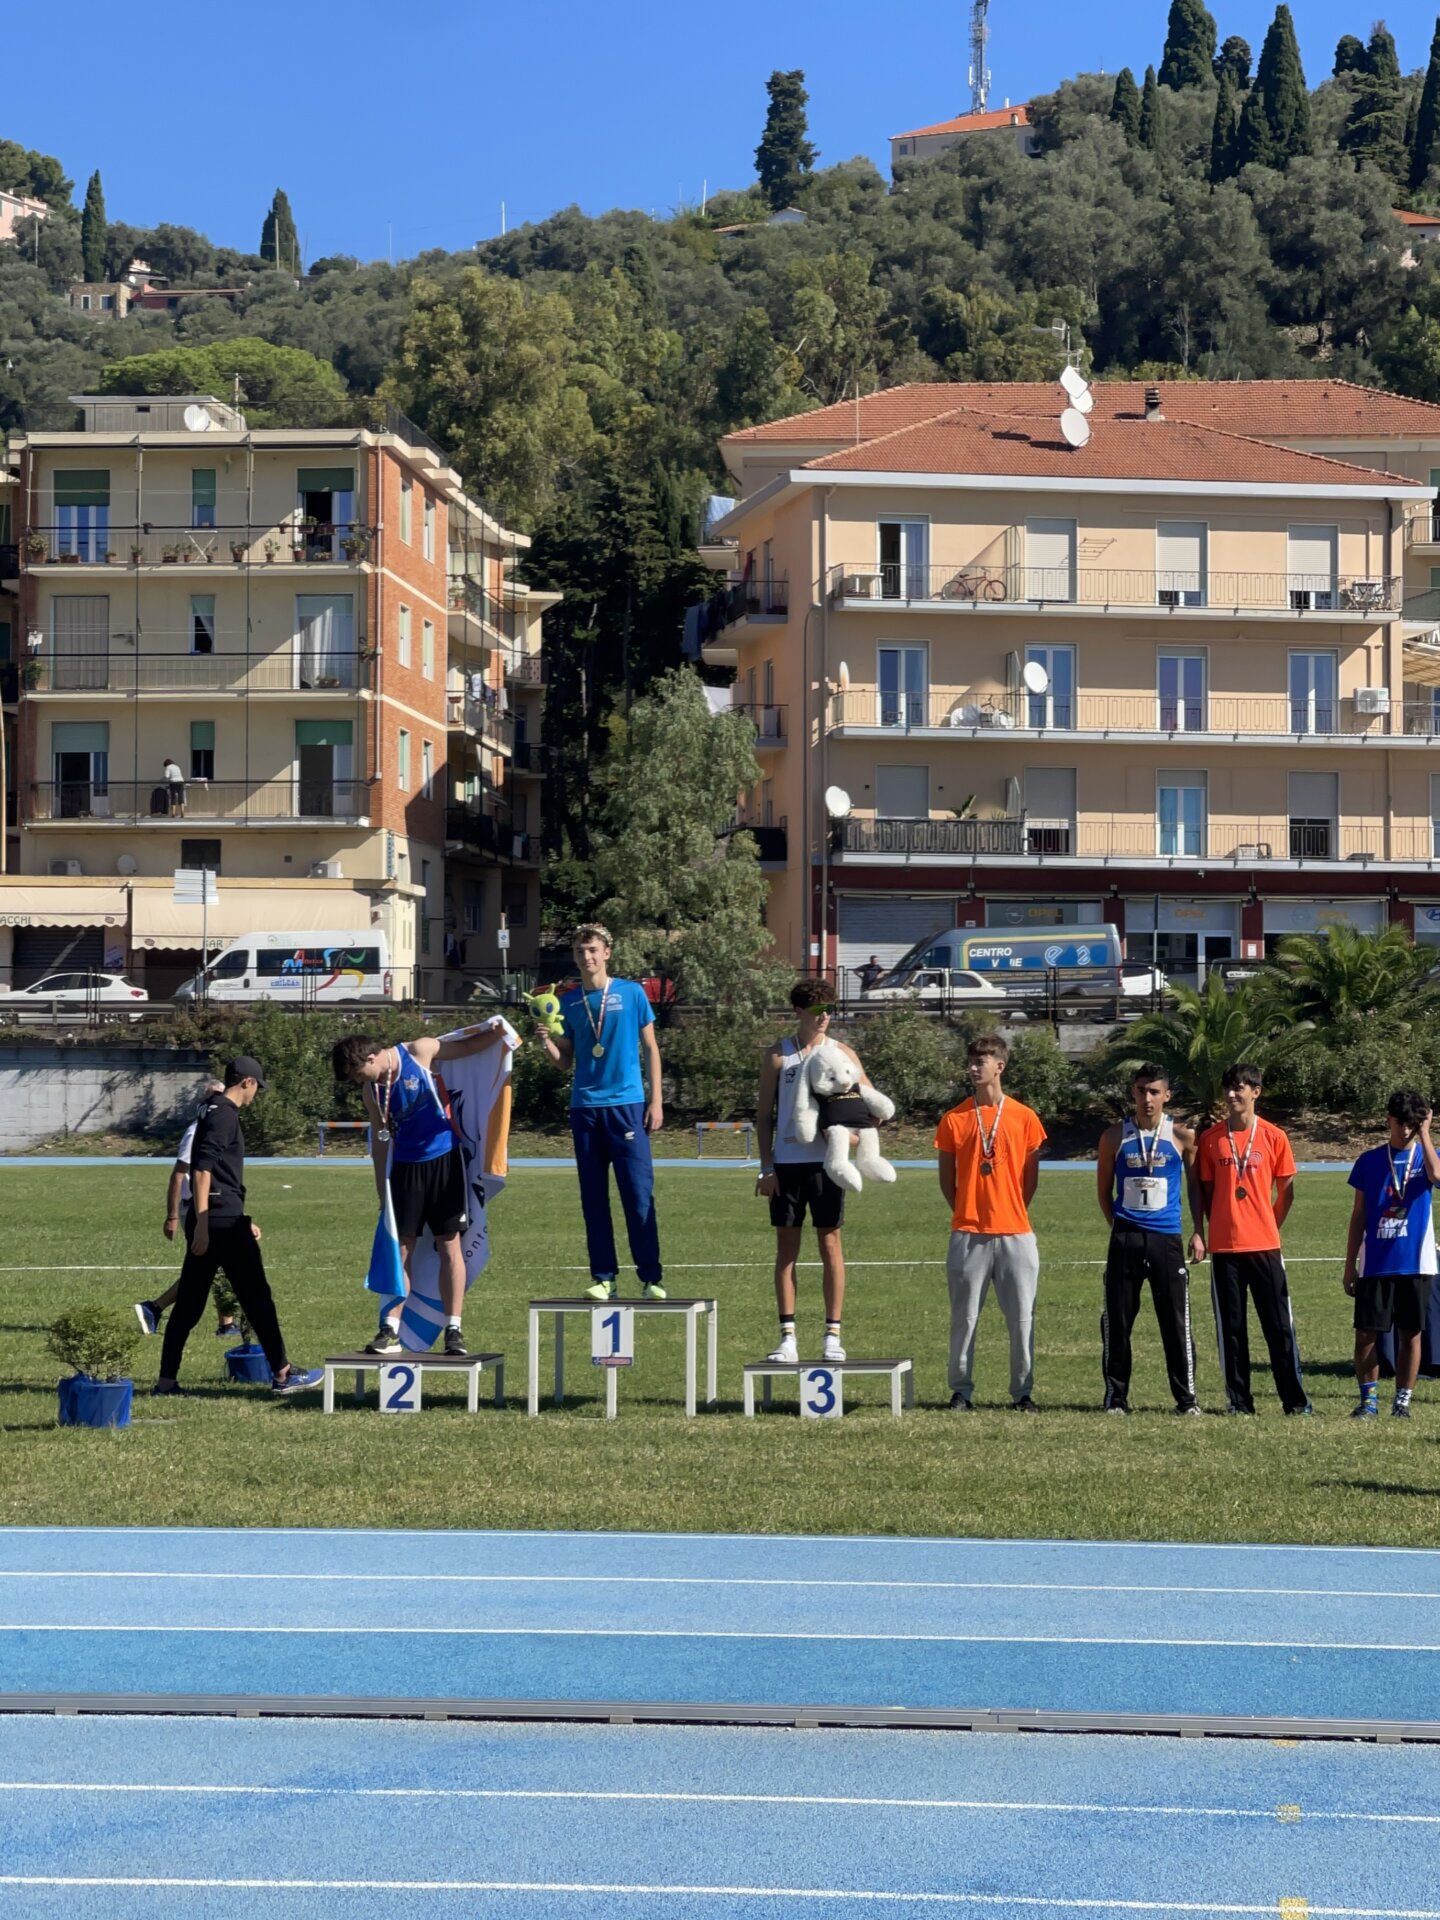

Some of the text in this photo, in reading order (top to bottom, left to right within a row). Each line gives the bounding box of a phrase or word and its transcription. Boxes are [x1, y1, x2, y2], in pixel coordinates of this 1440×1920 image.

[969, 947, 1012, 957] CENTRO
[1141, 1189, 1148, 1206] 1
[602, 1311, 620, 1353] 1
[386, 1366, 415, 1409] 2
[807, 1369, 836, 1414] 3
